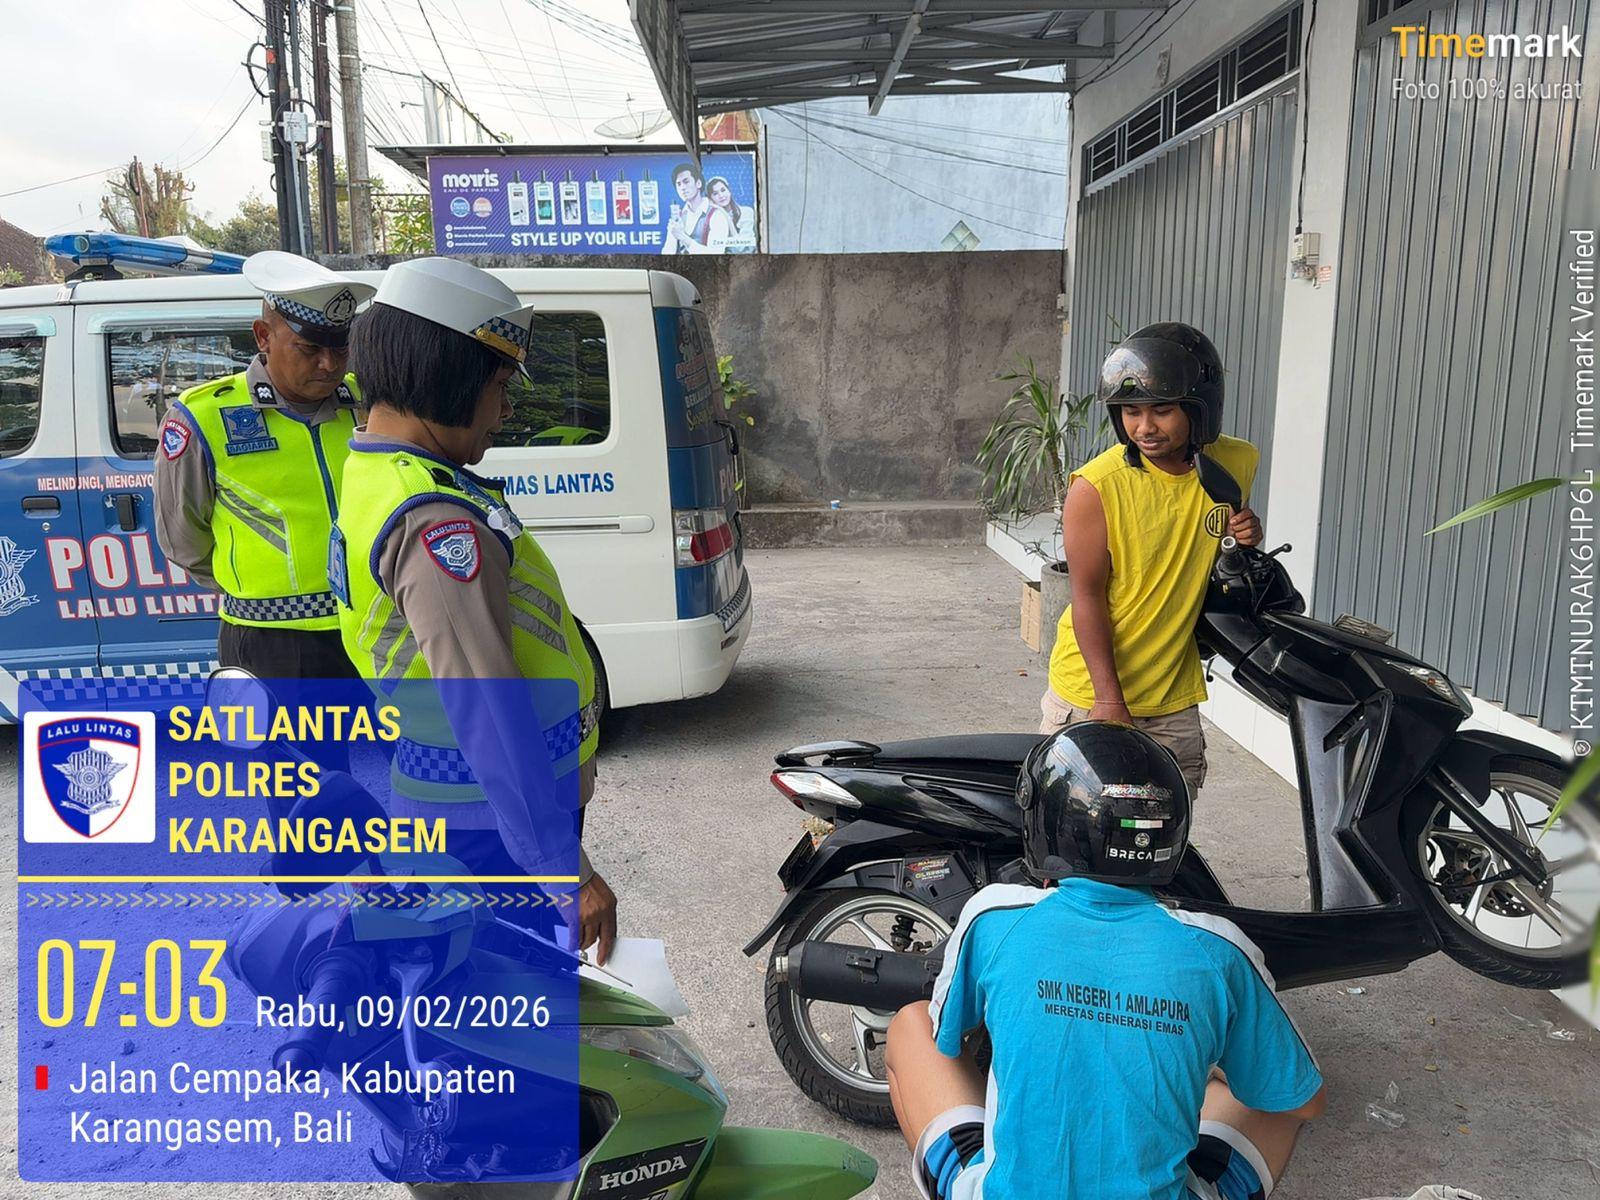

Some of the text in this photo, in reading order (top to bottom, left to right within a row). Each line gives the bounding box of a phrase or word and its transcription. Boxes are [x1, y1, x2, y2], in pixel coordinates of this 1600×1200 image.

[442, 168, 499, 188] morris
[511, 231, 662, 247] STYLE UP YOUR LIFE
[544, 472, 614, 494] LANTAS
[58, 593, 224, 620] LALU LINT
[1109, 847, 1153, 861] BRECA
[1037, 979, 1191, 1022] SMK NEGERI 1 AMLAPURA
[1044, 1003, 1184, 1036] MERETAS GENERASI EMAS
[600, 1155, 687, 1190] HONDA
